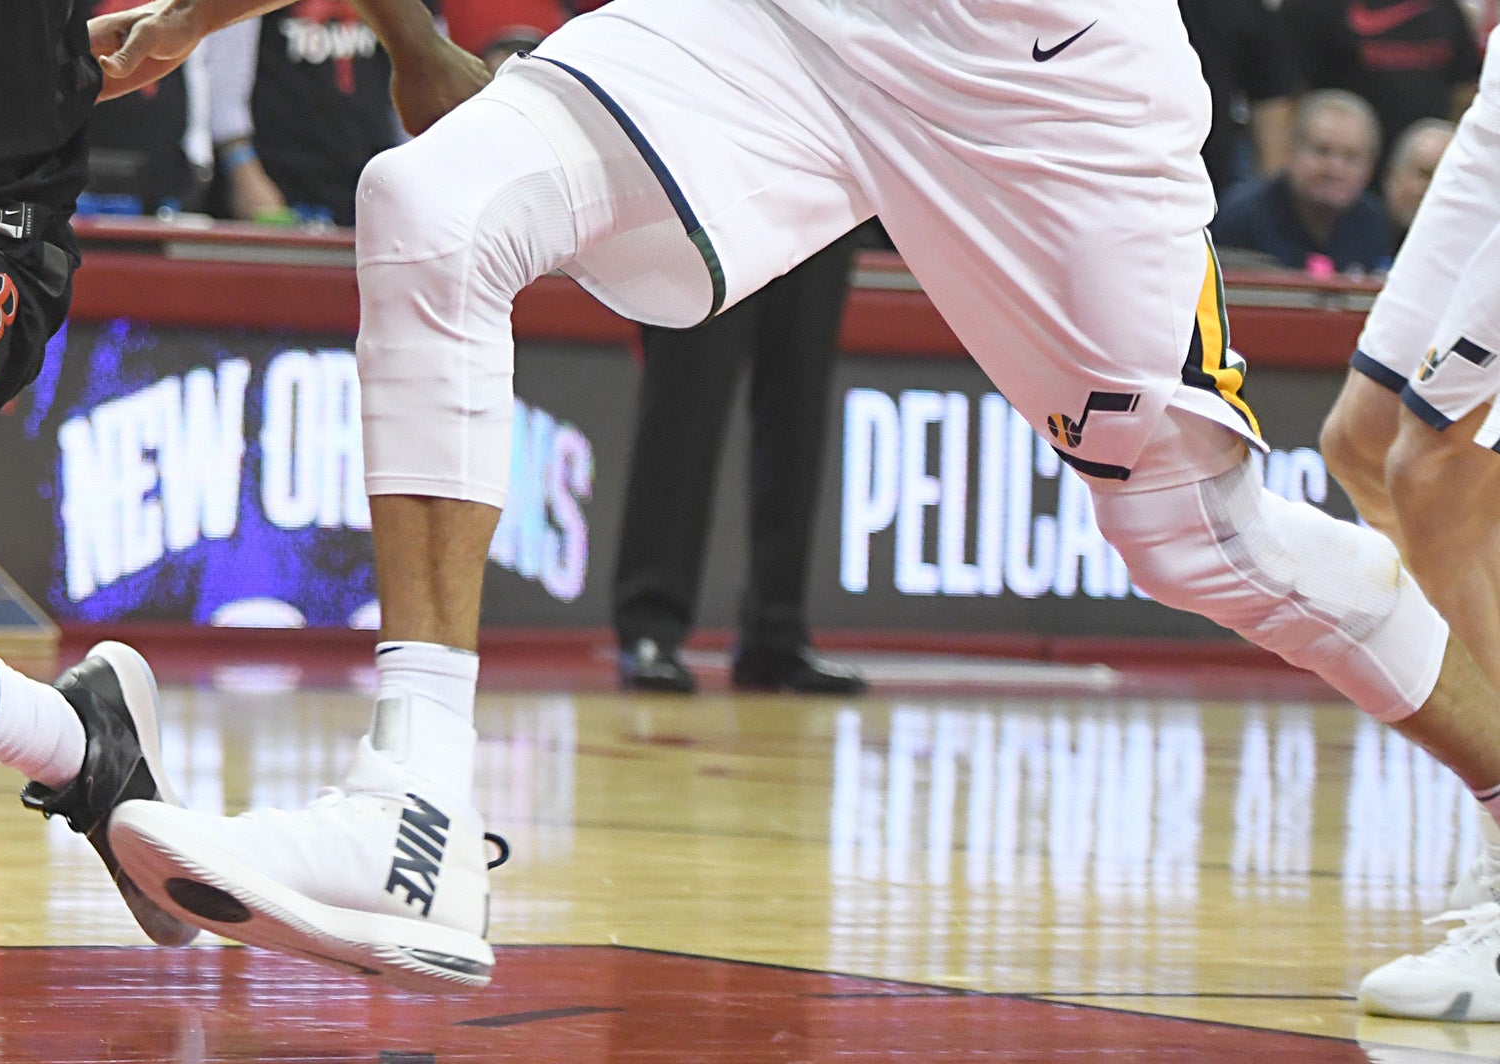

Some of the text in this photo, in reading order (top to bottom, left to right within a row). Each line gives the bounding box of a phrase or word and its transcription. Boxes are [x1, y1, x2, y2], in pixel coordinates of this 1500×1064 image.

[59, 349, 594, 602] NEW ORNS
[385, 792, 450, 918] NIKE
